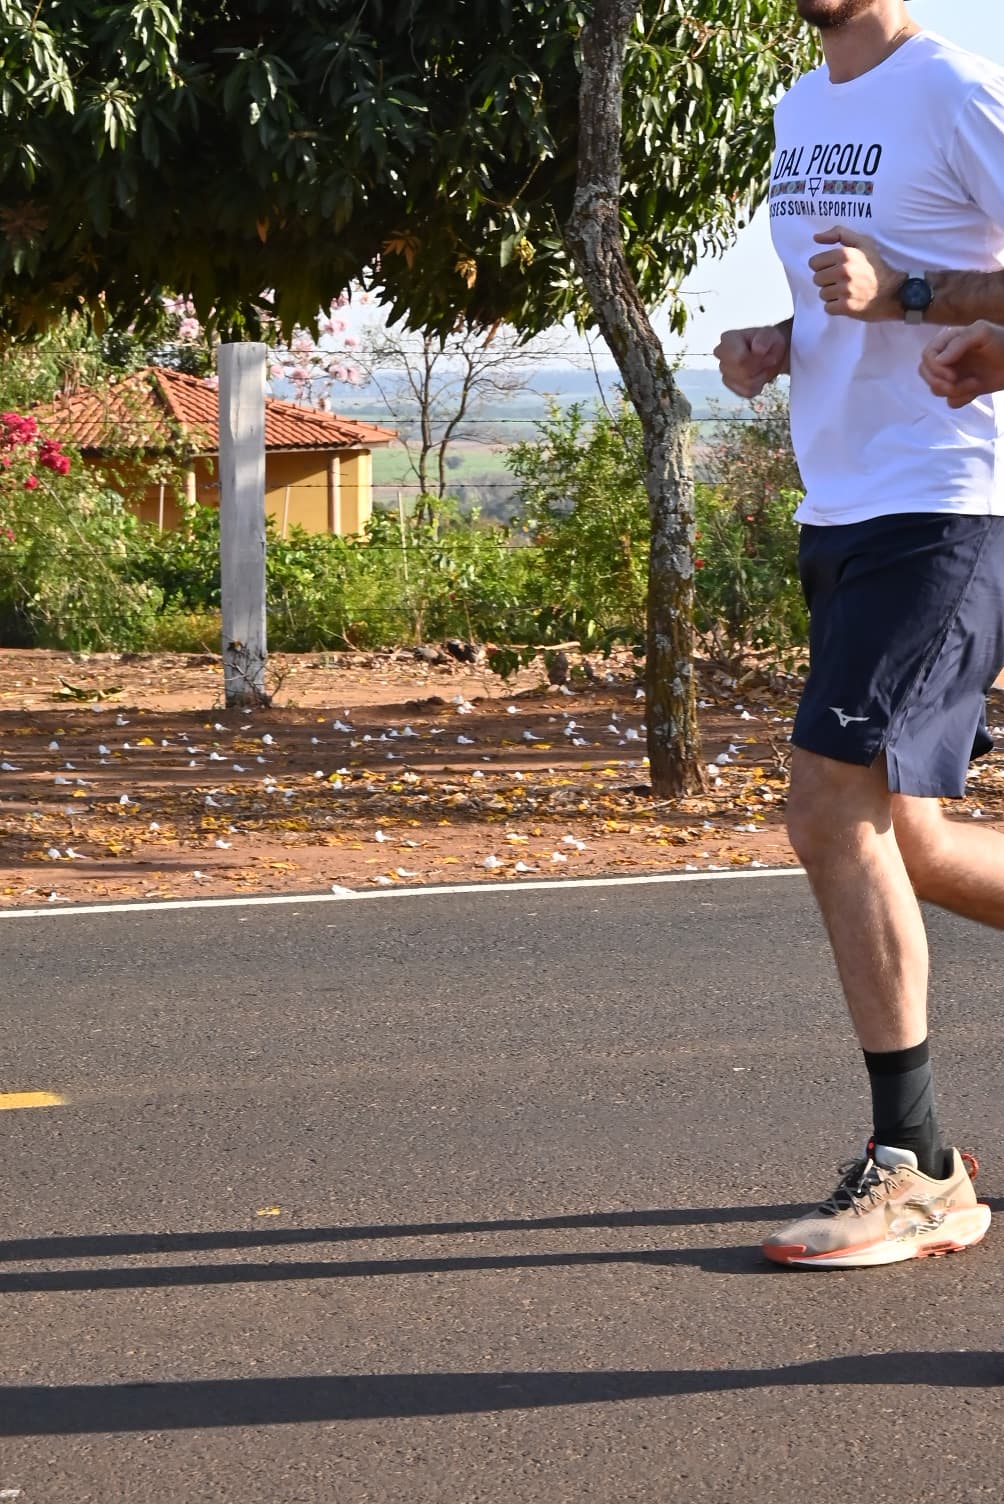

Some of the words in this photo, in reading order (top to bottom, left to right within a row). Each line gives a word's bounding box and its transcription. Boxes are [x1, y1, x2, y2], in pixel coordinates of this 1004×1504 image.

[774, 146, 804, 181] DAL
[805, 143, 883, 176] PICOLO
[818, 200, 872, 219] ESPORTIVA
